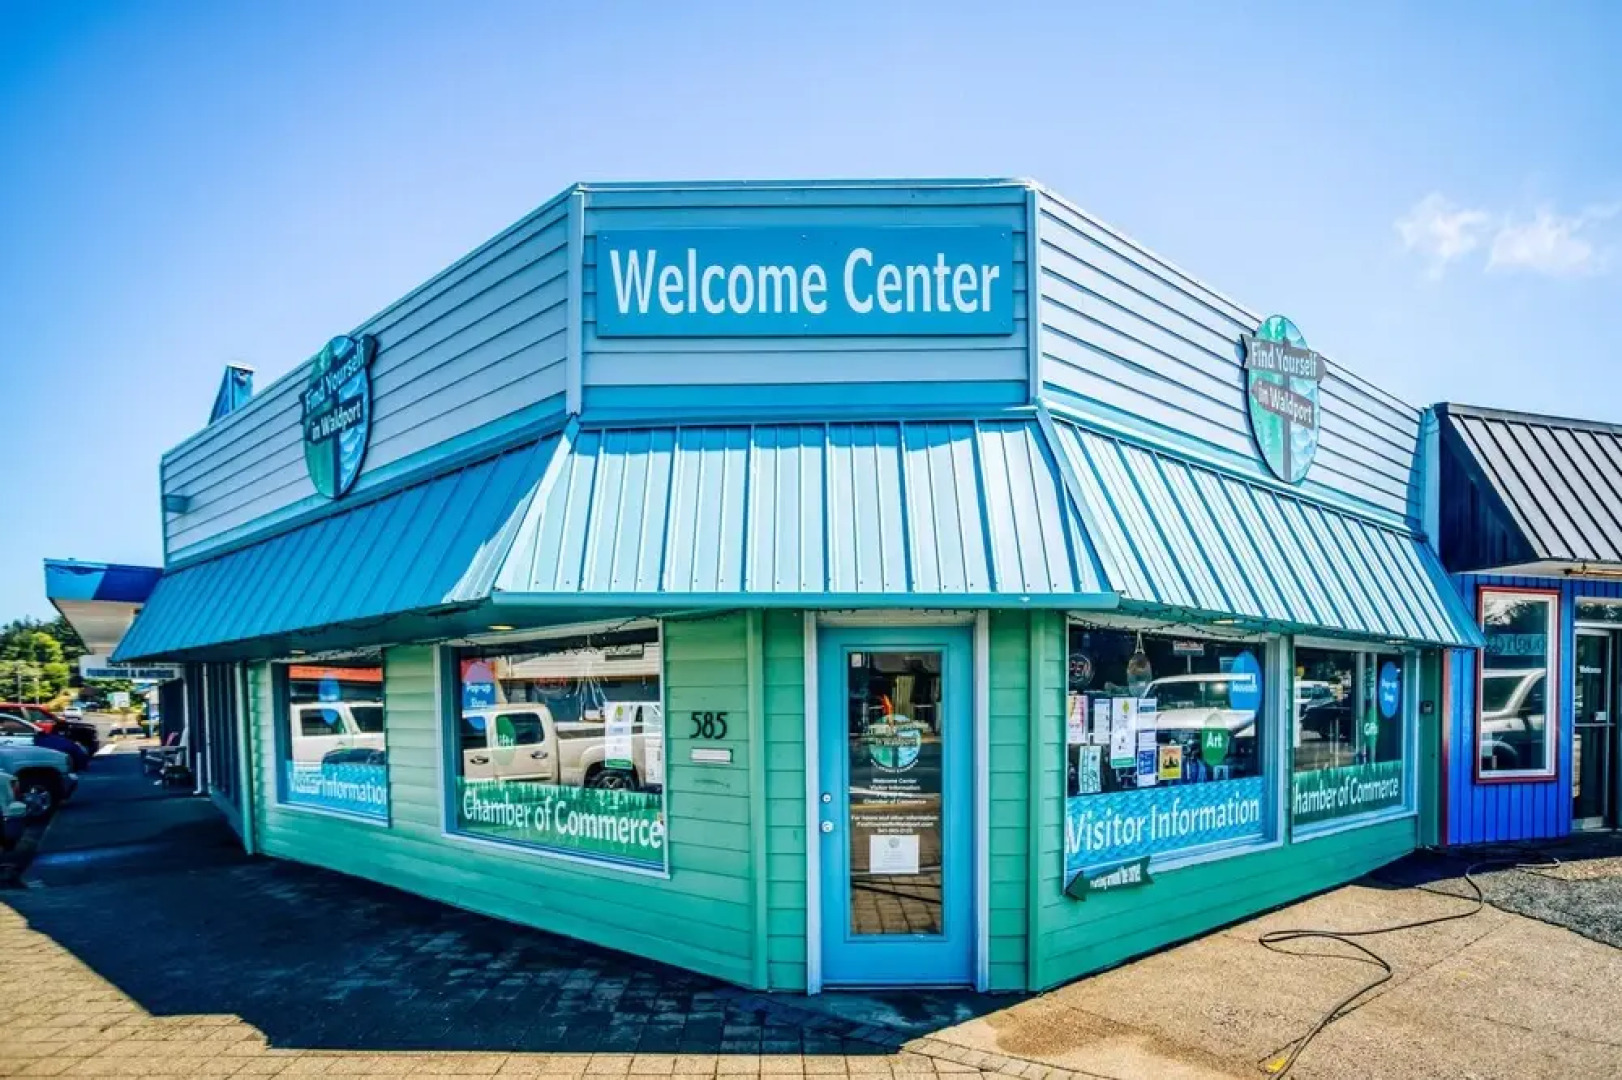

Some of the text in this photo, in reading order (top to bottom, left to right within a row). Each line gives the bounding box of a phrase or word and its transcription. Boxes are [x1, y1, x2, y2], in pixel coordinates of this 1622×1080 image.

[610, 247, 1000, 314] Welcome Center
[305, 338, 364, 413] Find Yourself
[1251, 341, 1317, 377] Find Yourself
[312, 400, 361, 442] in Waldport
[1258, 380, 1312, 424] in Waldport
[689, 711, 728, 740] 585
[1206, 731, 1222, 748] Art
[1337, 774, 1350, 807] of
[1350, 777, 1399, 804] Commerce
[463, 789, 662, 849] Chamber of Commerce
[1066, 791, 1260, 853] Visitor Information
